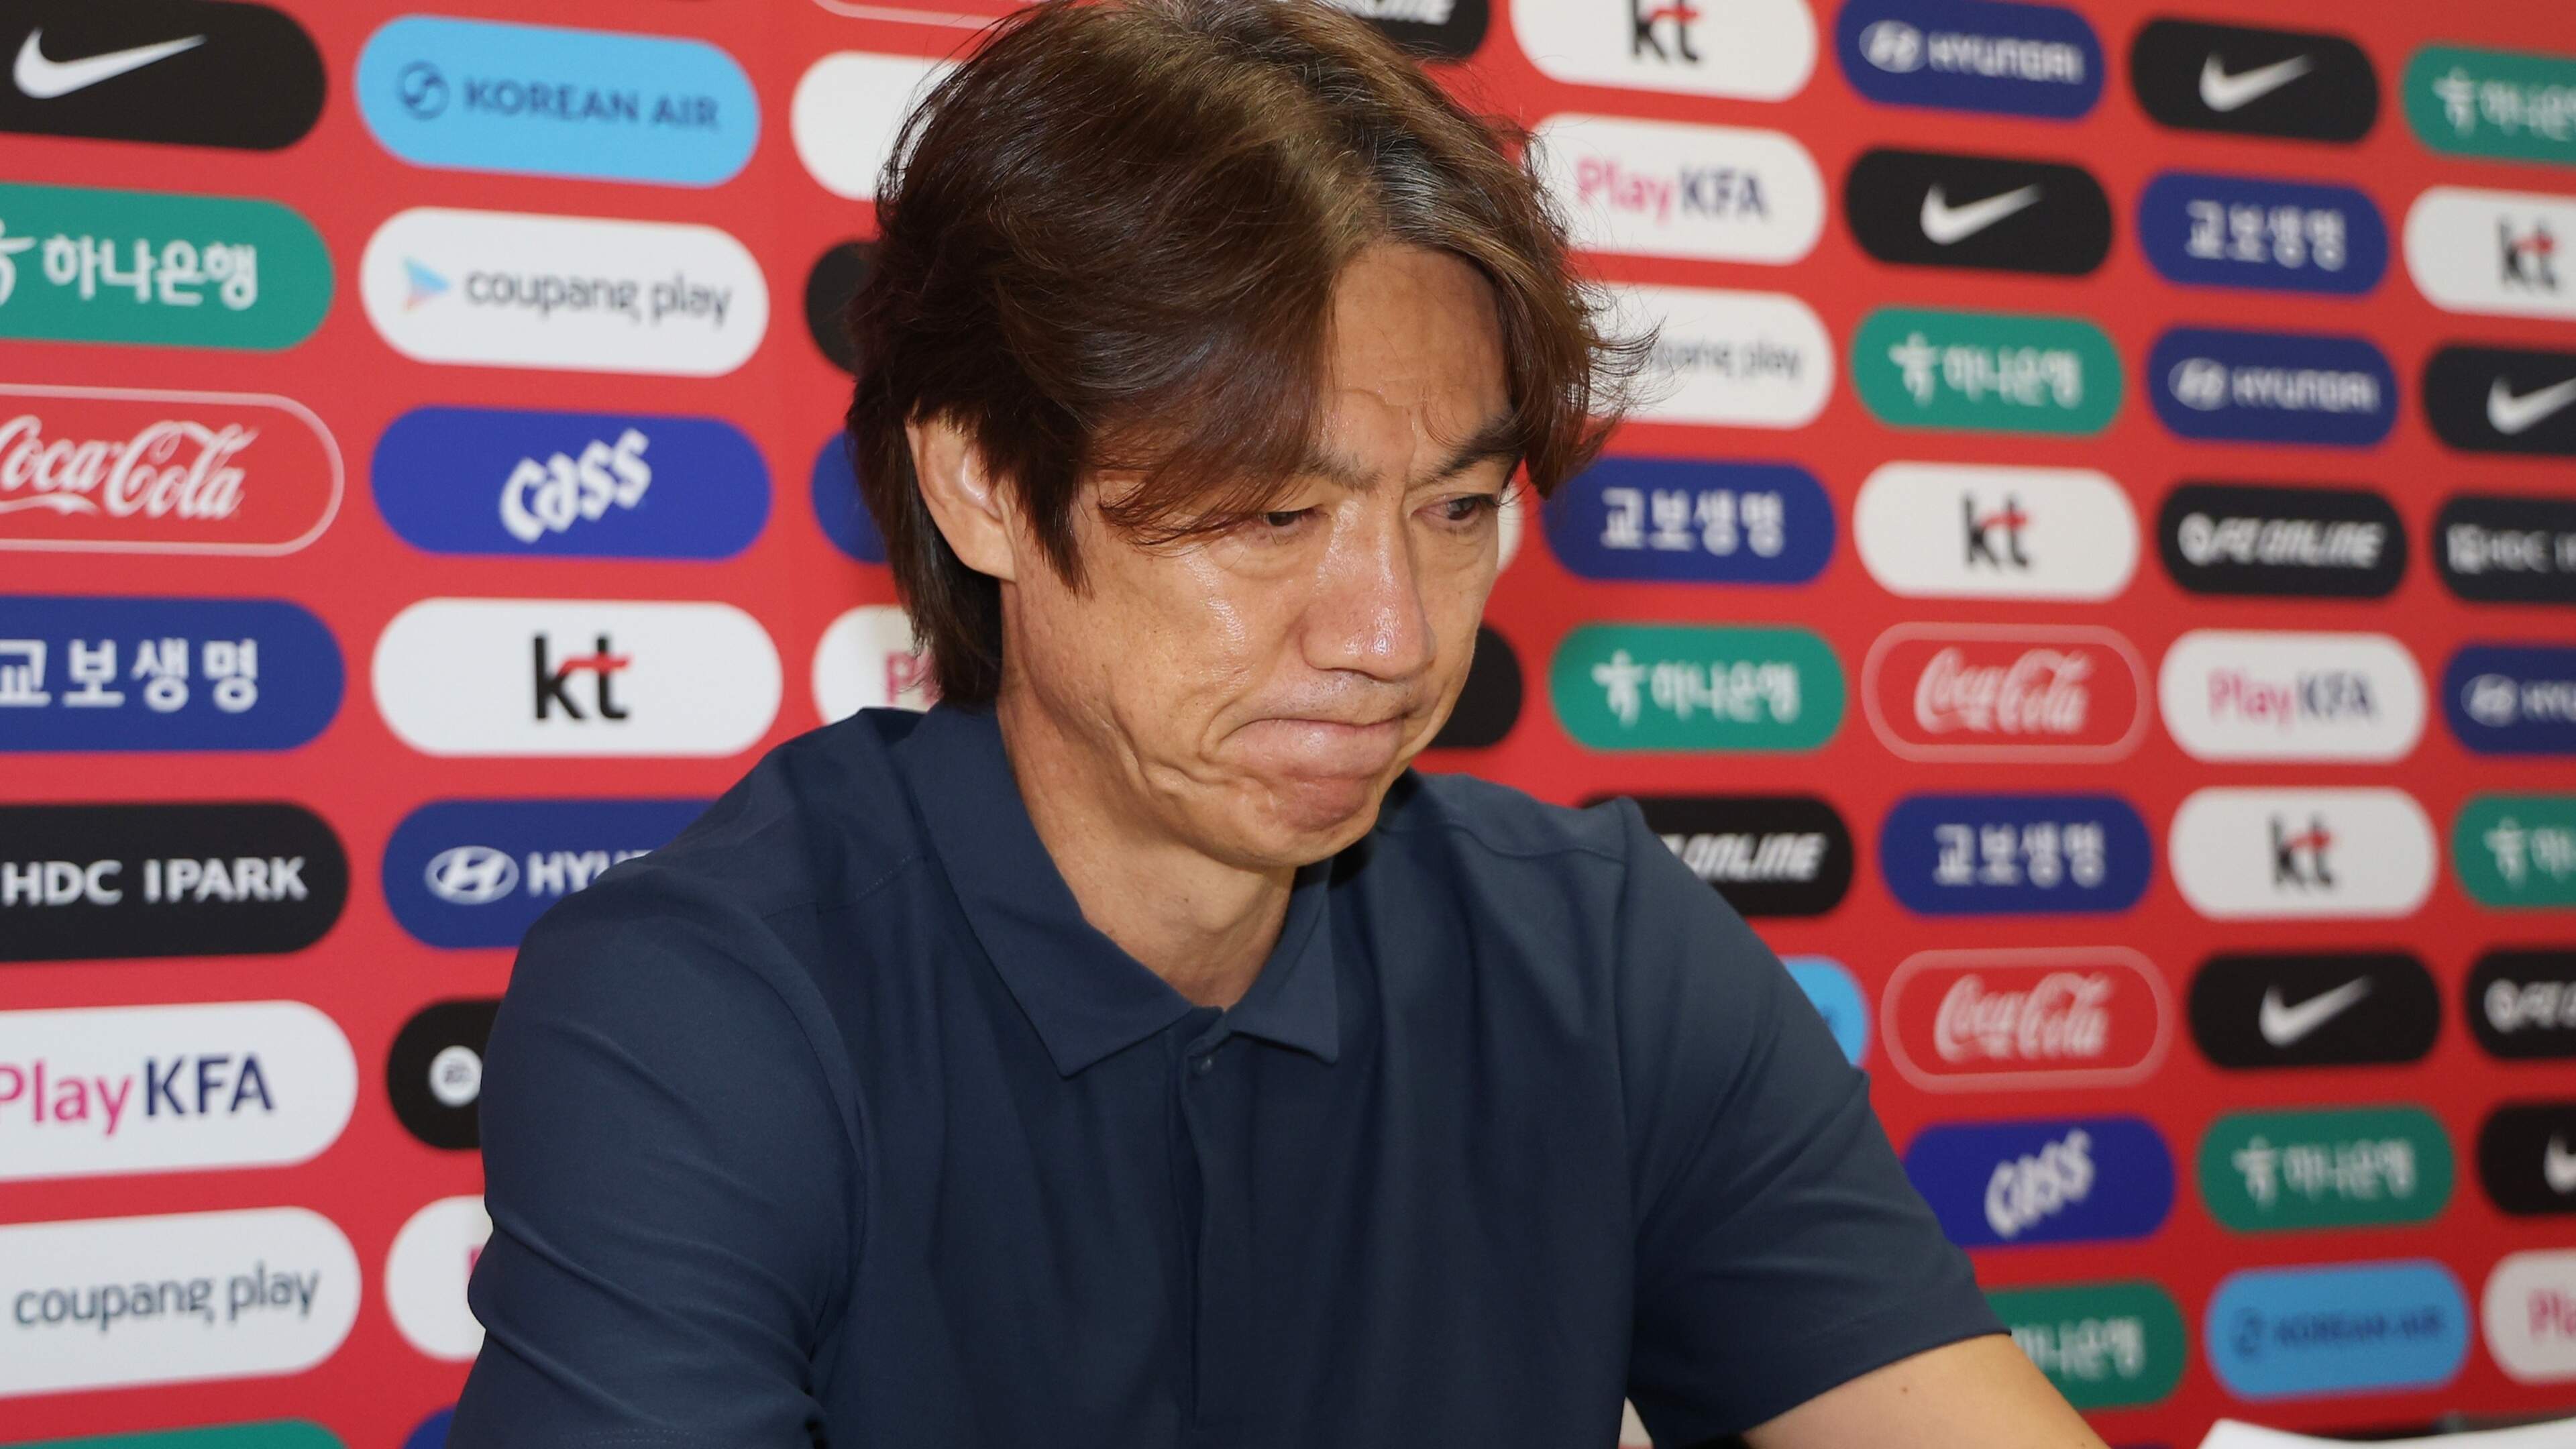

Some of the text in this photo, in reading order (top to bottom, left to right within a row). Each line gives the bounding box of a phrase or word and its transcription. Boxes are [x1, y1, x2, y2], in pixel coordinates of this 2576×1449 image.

[1630, 0, 1702, 63] kt
[463, 76, 721, 129] KOREAN AIR
[42, 233, 260, 311] 하나은행
[466, 270, 733, 328] coupang play
[1599, 487, 1785, 557] 교보생명
[1962, 491, 2032, 573] kt
[0, 637, 259, 713] 교보생명
[533, 633, 635, 722] kt
[1, 855, 309, 907] HDC IPARK
[2268, 810, 2339, 893] kt
[13, 1260, 322, 1333] coupang play
